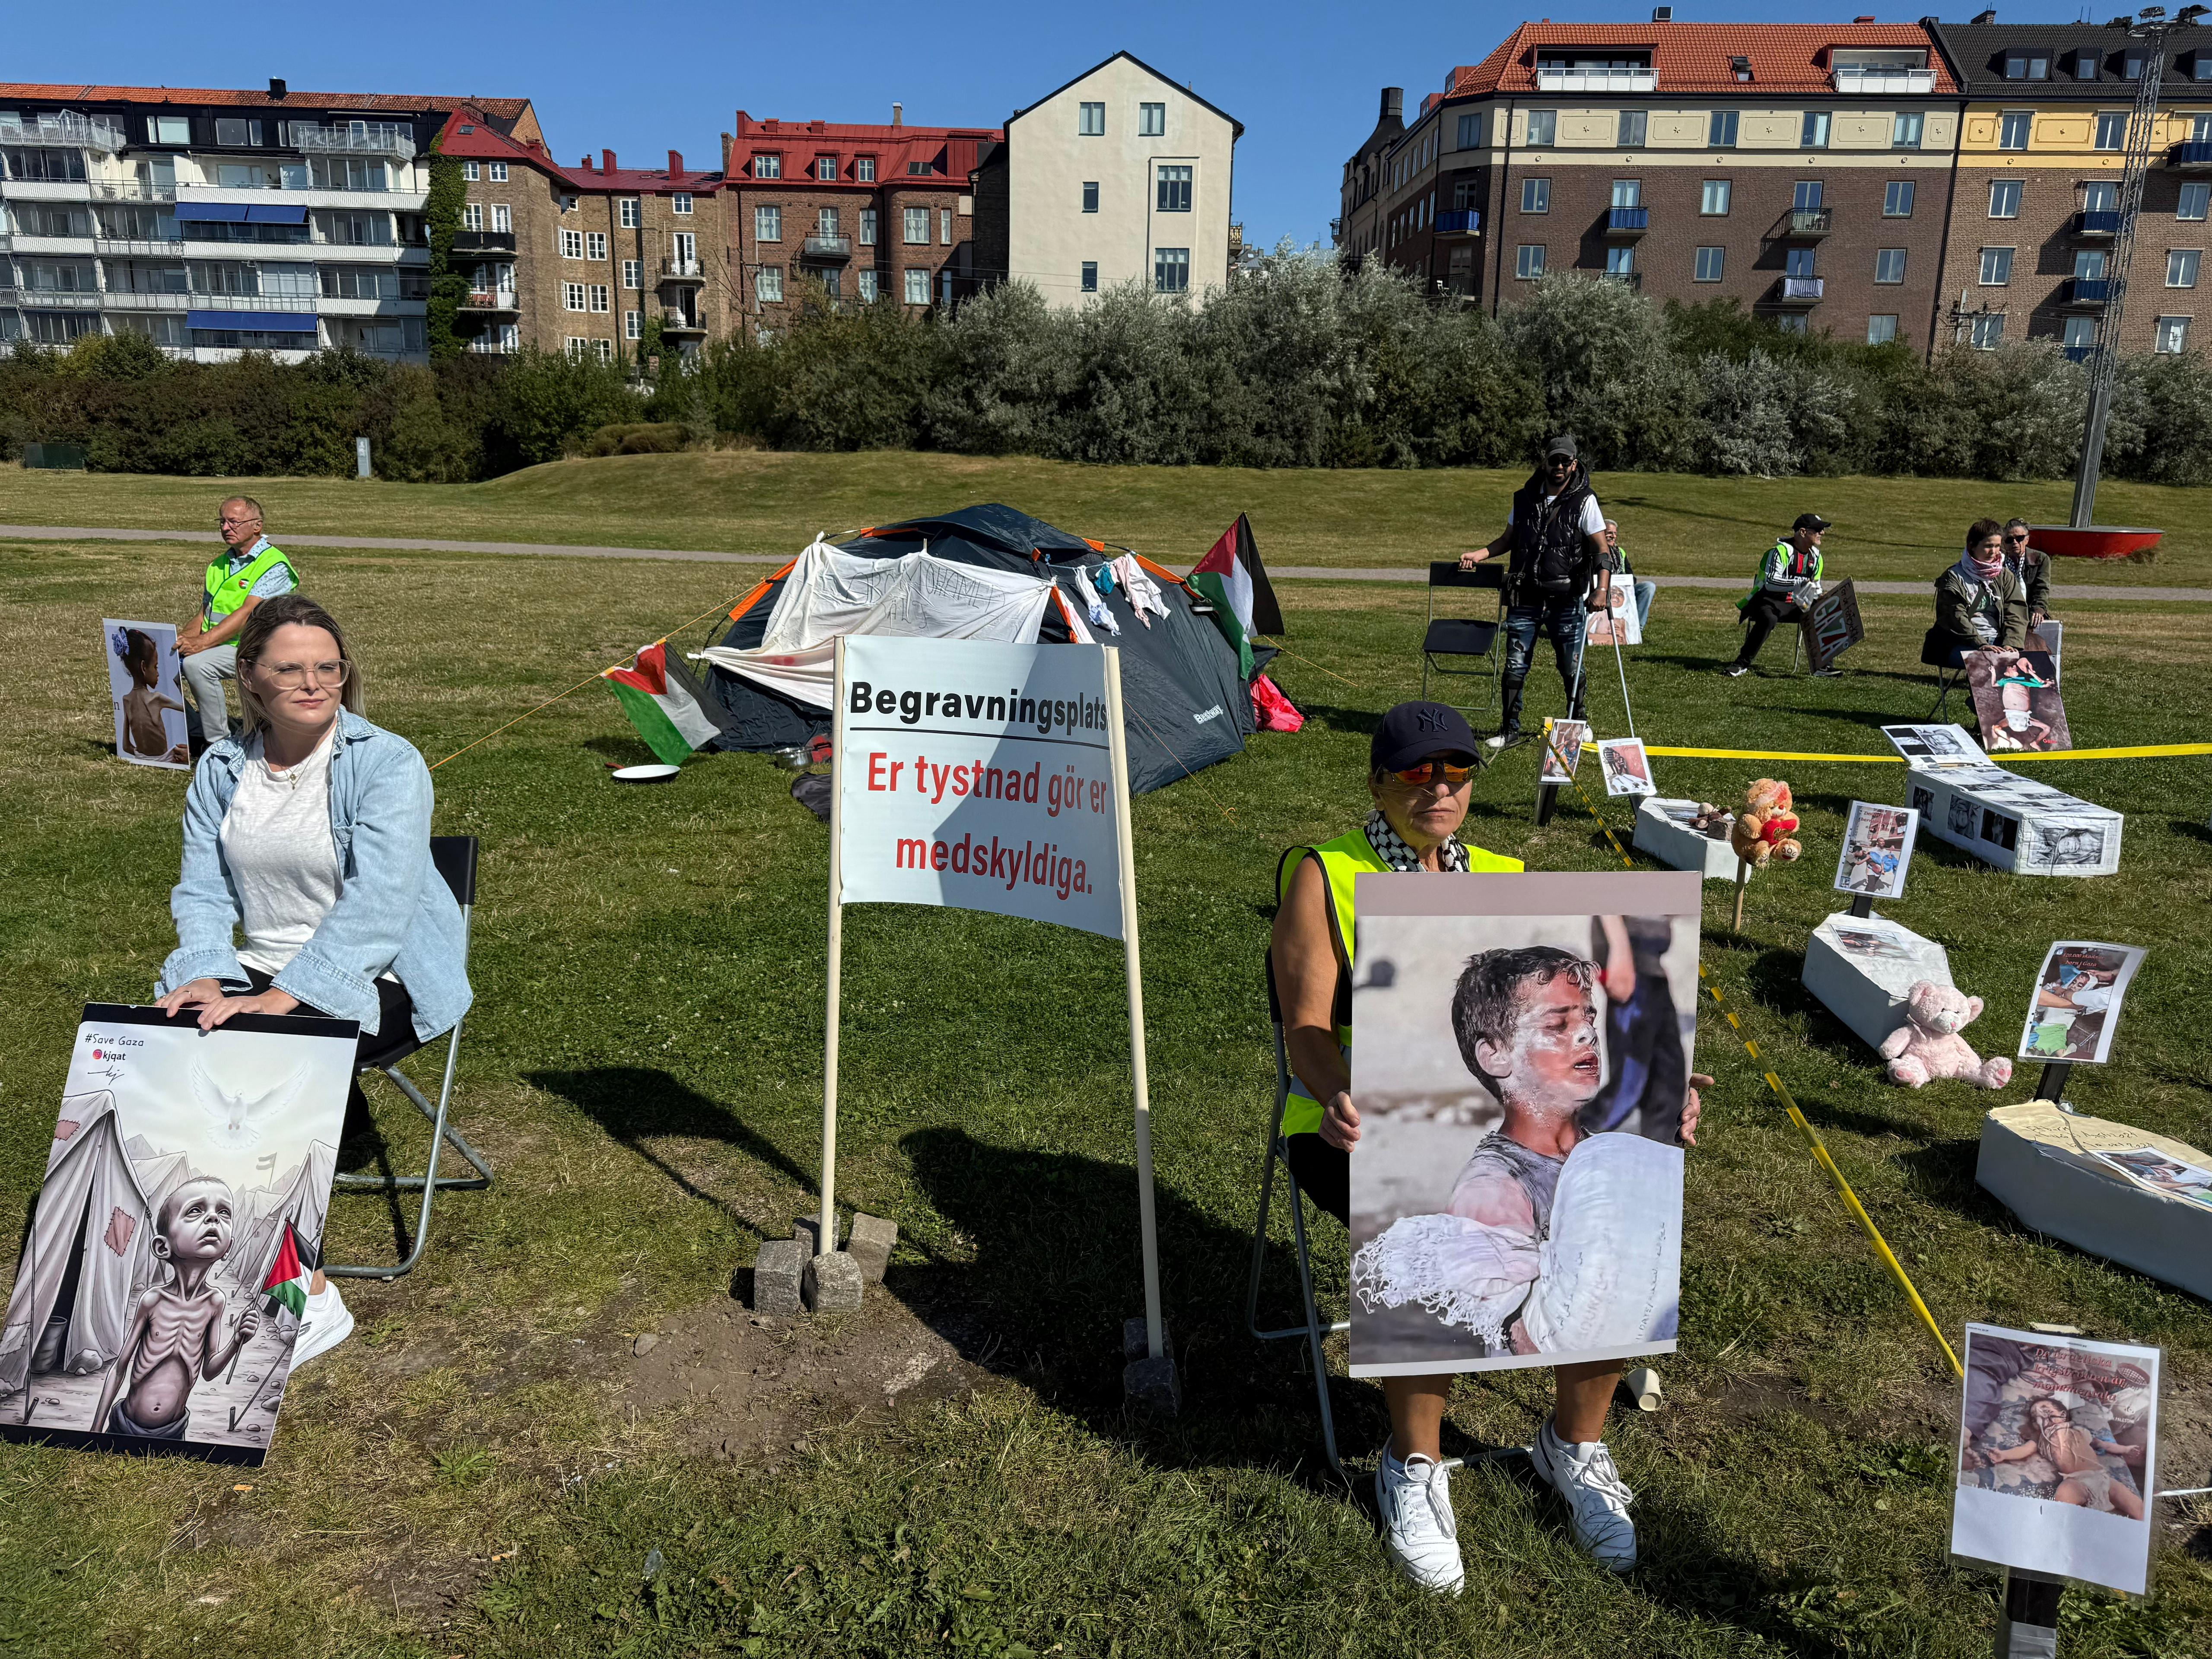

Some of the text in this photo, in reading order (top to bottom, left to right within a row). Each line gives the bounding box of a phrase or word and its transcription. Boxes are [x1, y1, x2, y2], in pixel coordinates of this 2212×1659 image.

[1814, 595, 1849, 661] GAZA
[850, 681, 1107, 736] Begravningsplats
[1193, 704, 1224, 725] Bestway
[868, 752, 1107, 817] Er tystnad gör er
[896, 833, 1093, 900] medskyldiga.
[85, 1033, 144, 1046] #Save Gaza
[103, 1050, 126, 1062] kjqat
